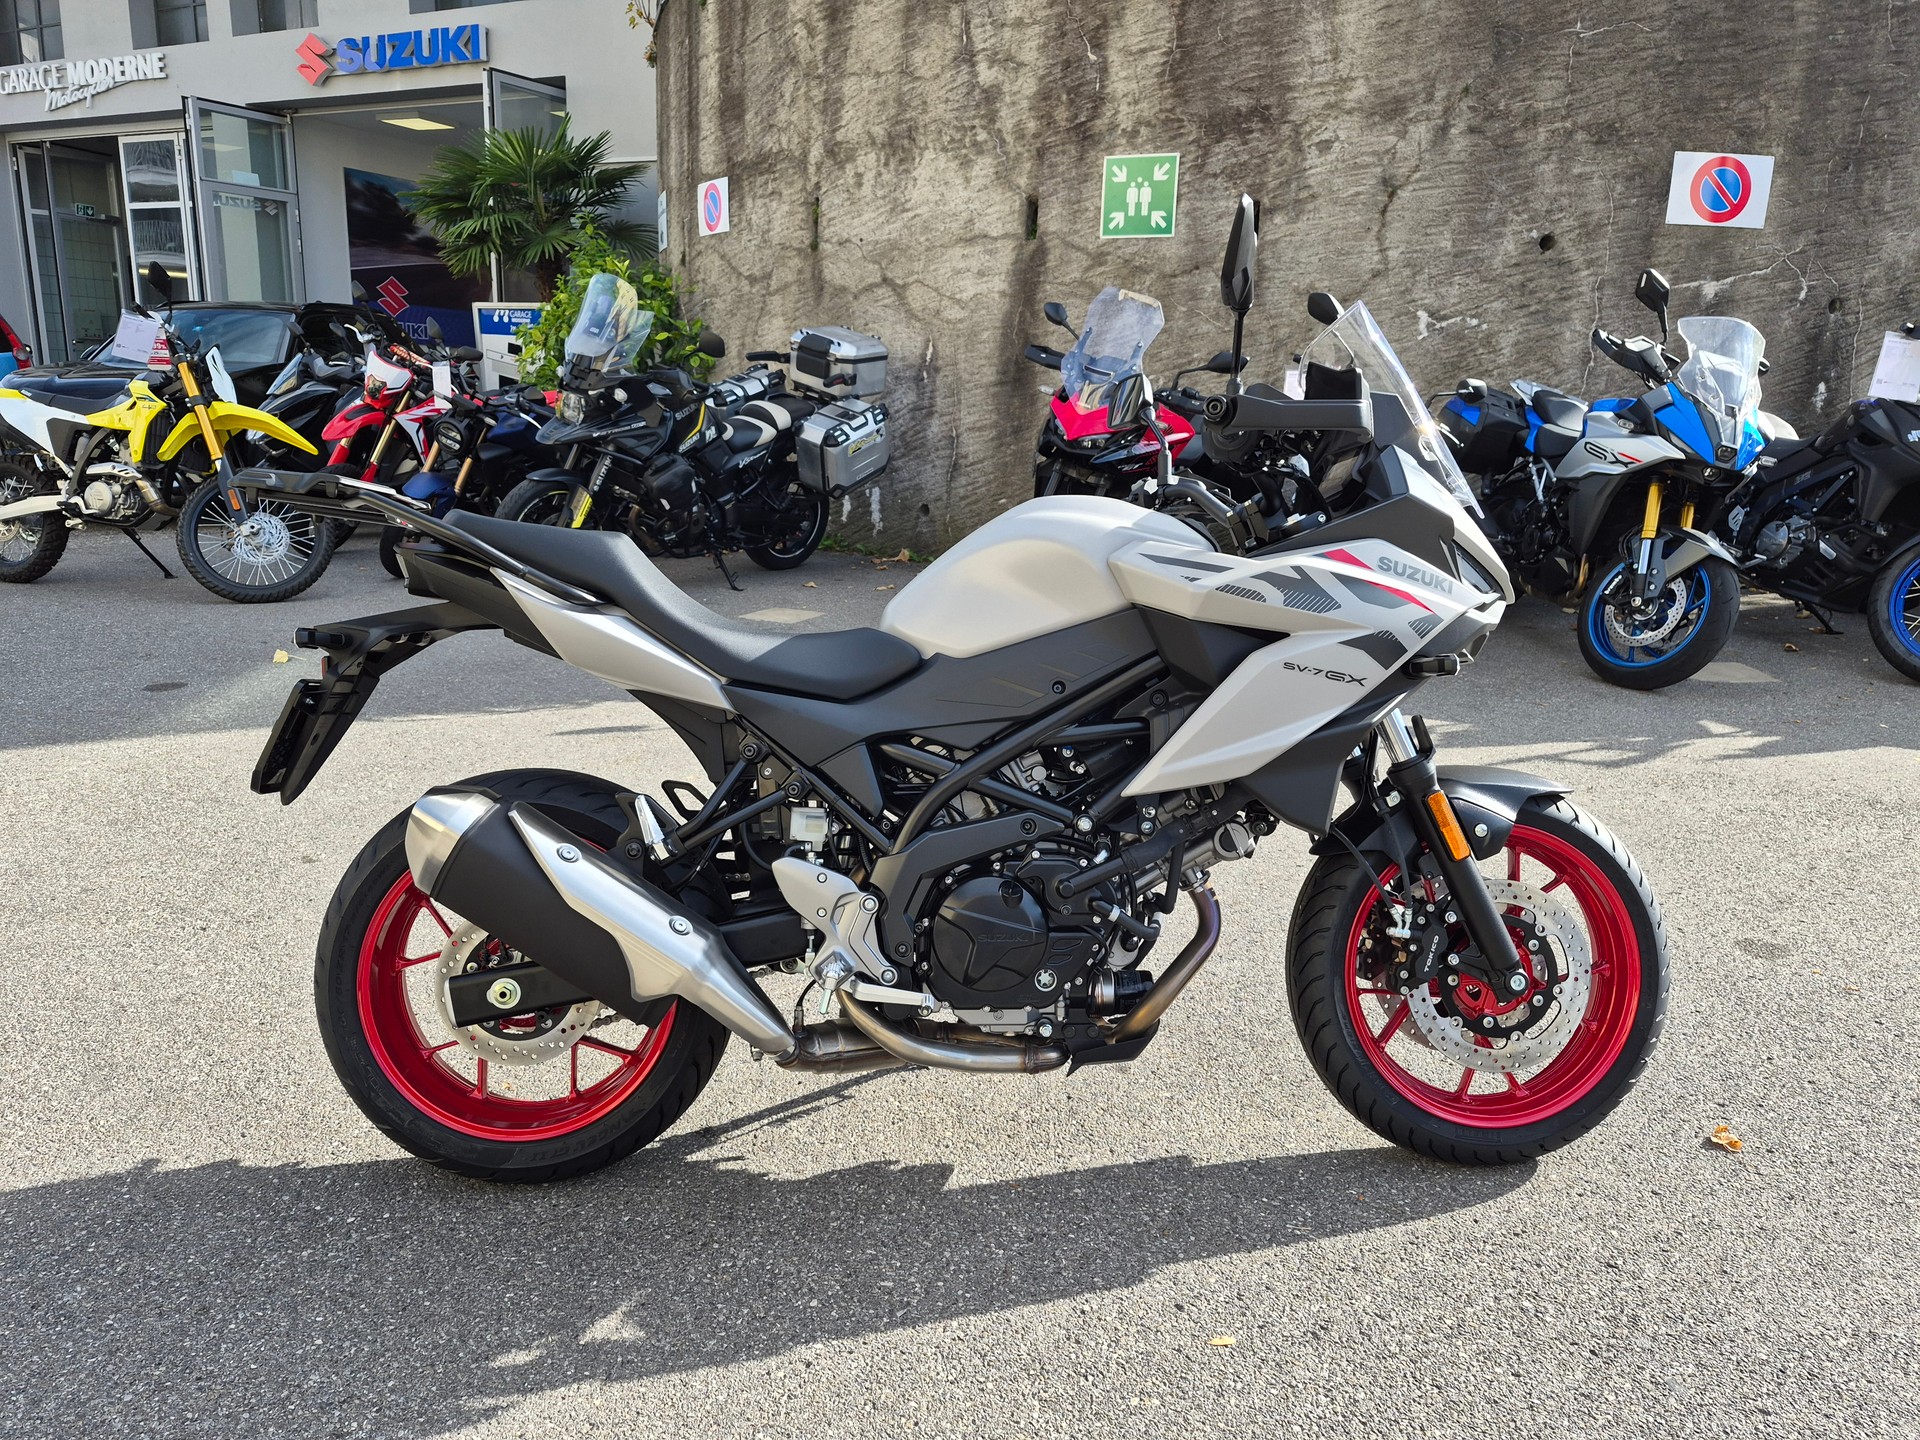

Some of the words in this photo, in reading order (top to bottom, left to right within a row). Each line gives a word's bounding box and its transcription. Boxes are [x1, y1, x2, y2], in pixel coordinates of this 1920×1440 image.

[336, 23, 481, 73] SUZUKI
[0, 63, 63, 95] GARAGE
[66, 52, 167, 85] MODERNE
[509, 310, 532, 318] GARAGE
[678, 432, 700, 453] SUZUKI
[1377, 556, 1454, 595] SUZUKI
[1423, 935, 1440, 973] TOKICO
